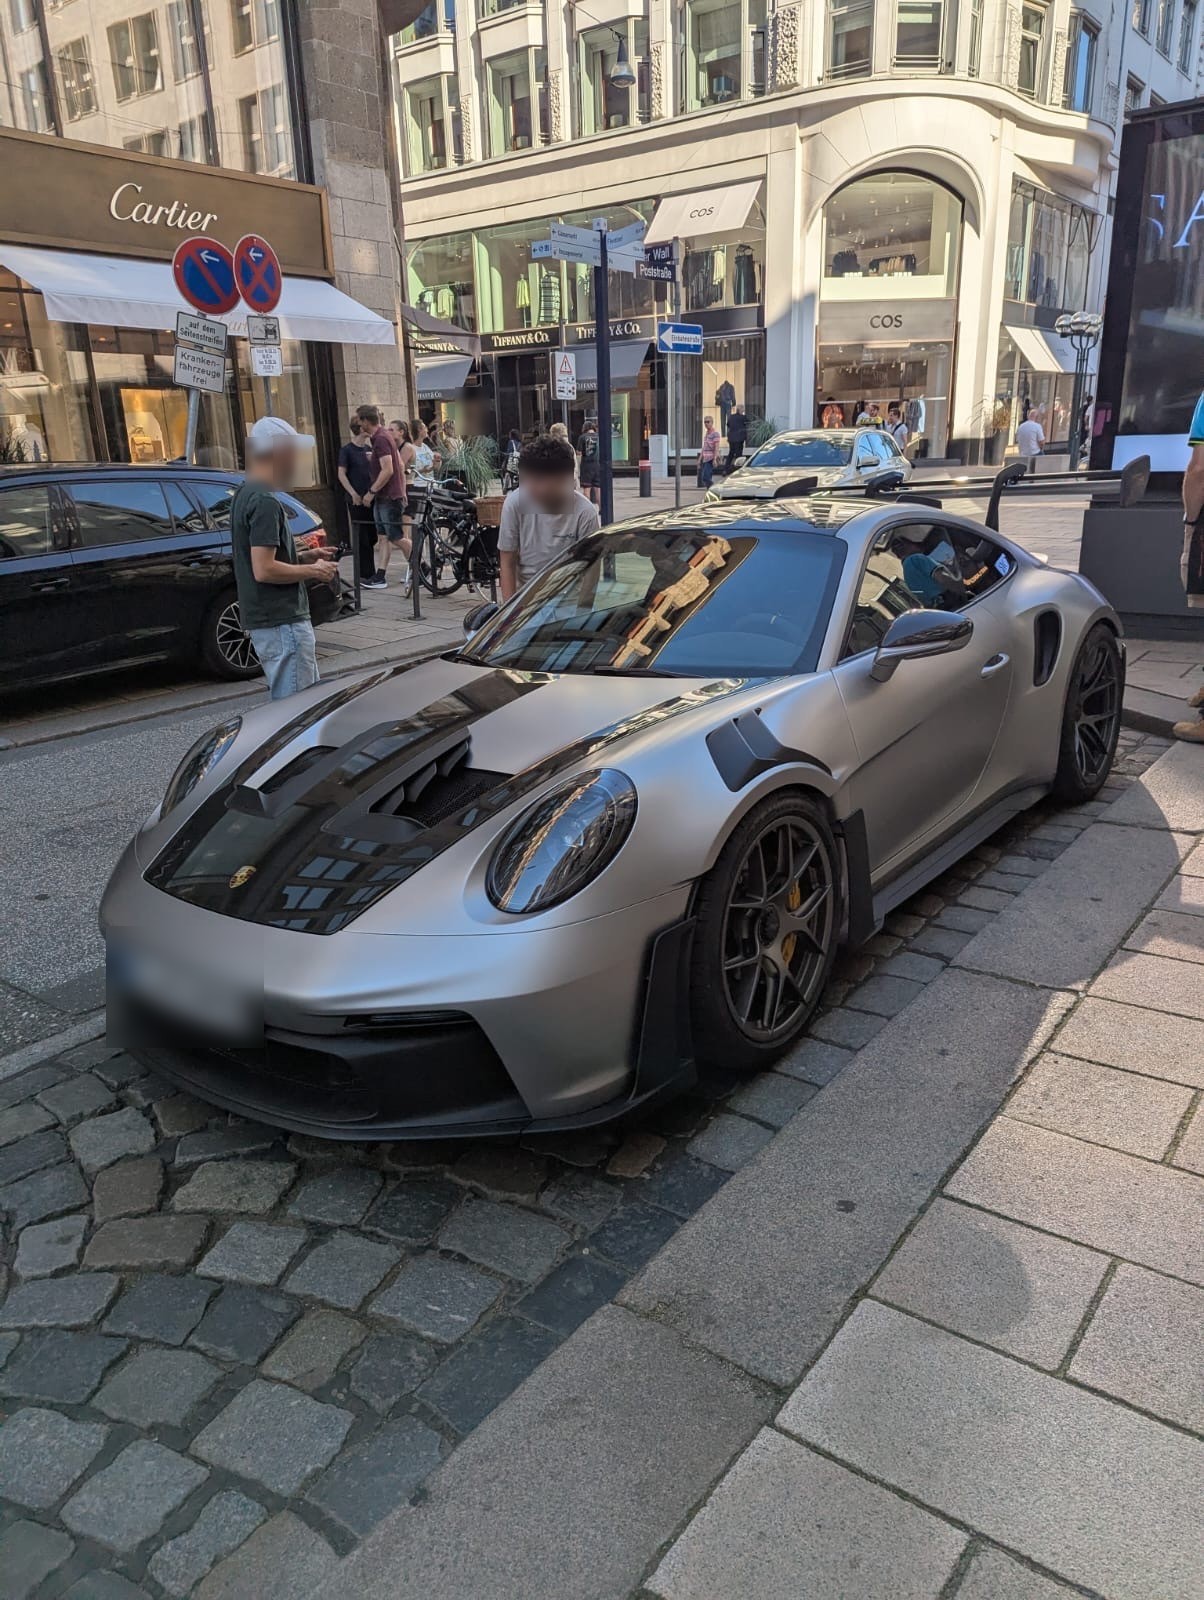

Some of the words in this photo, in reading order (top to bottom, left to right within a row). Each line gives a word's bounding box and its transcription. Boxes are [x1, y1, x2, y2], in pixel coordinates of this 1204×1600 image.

[110, 182, 218, 231] Cartier
[689, 206, 714, 219] COS
[652, 246, 670, 260] Wall
[639, 263, 672, 279] Poststraße
[189, 321, 200, 329] auf
[202, 324, 216, 334] dem
[869, 314, 903, 329] COS
[181, 351, 220, 366] Kranken-
[192, 375, 207, 385] frei
